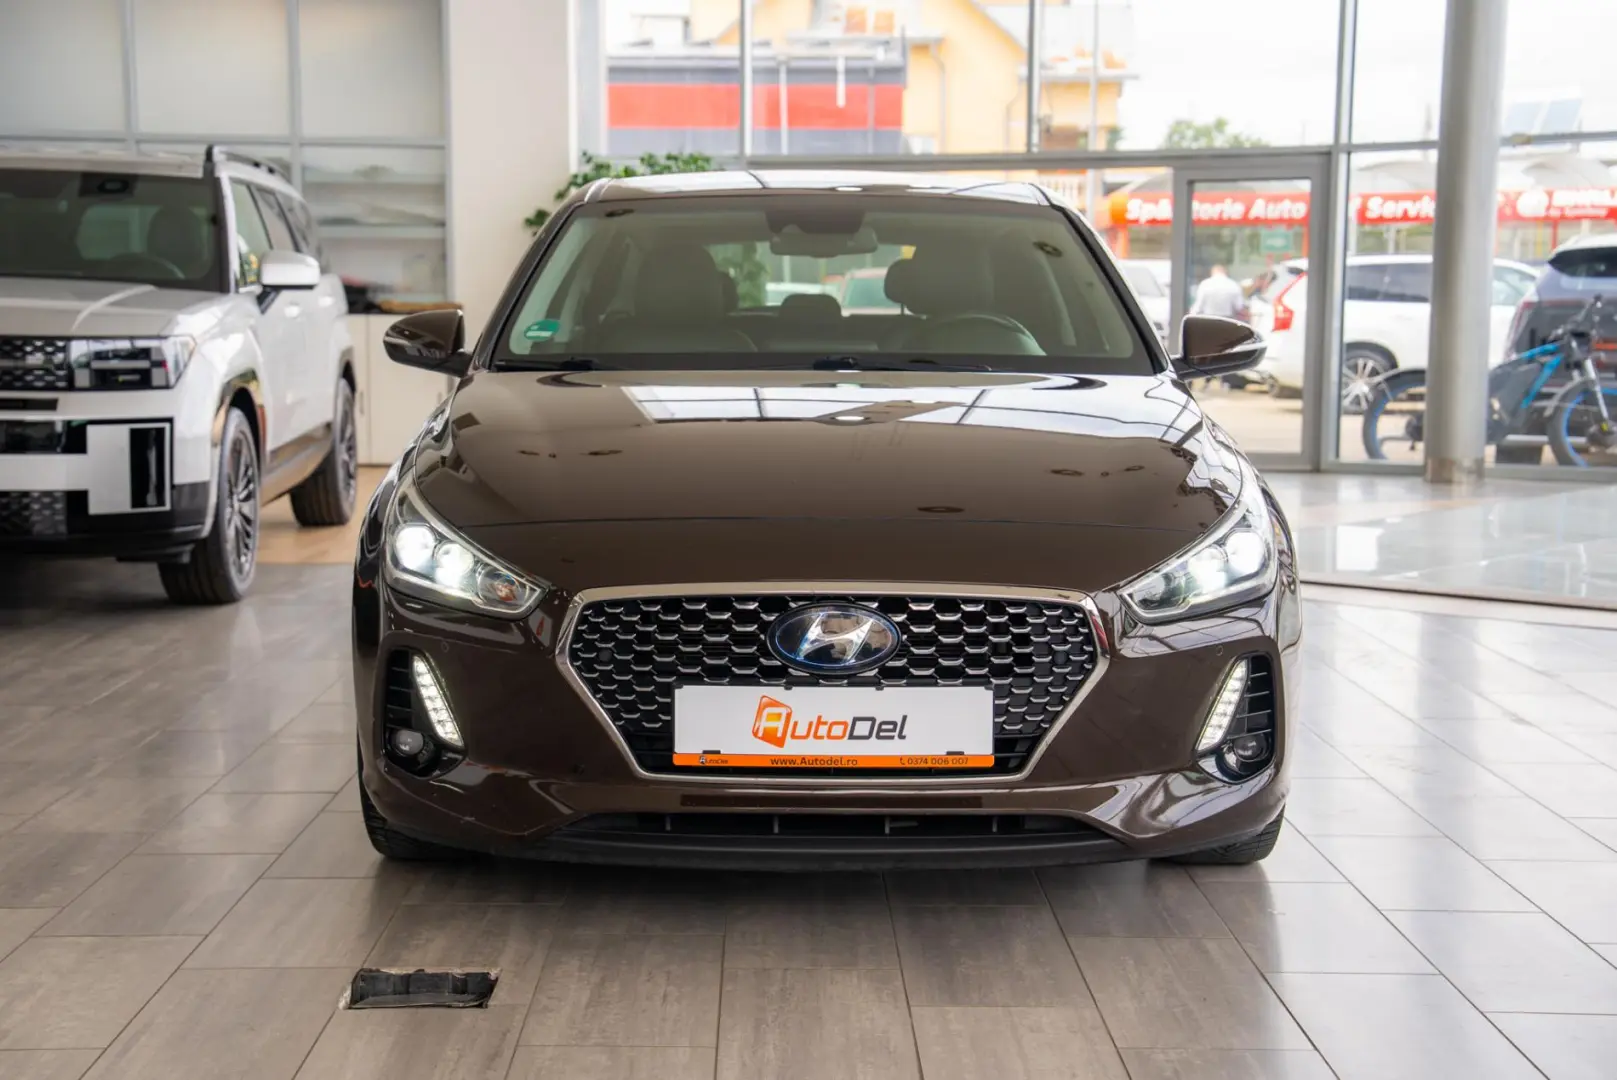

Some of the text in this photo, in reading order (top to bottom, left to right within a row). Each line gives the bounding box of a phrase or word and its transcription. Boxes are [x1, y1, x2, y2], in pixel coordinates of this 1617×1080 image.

[1248, 198, 1307, 219] Auto
[755, 703, 908, 741] AutoDel
[770, 756, 858, 766] www.Autodel.ro
[907, 757, 928, 765] 0374
